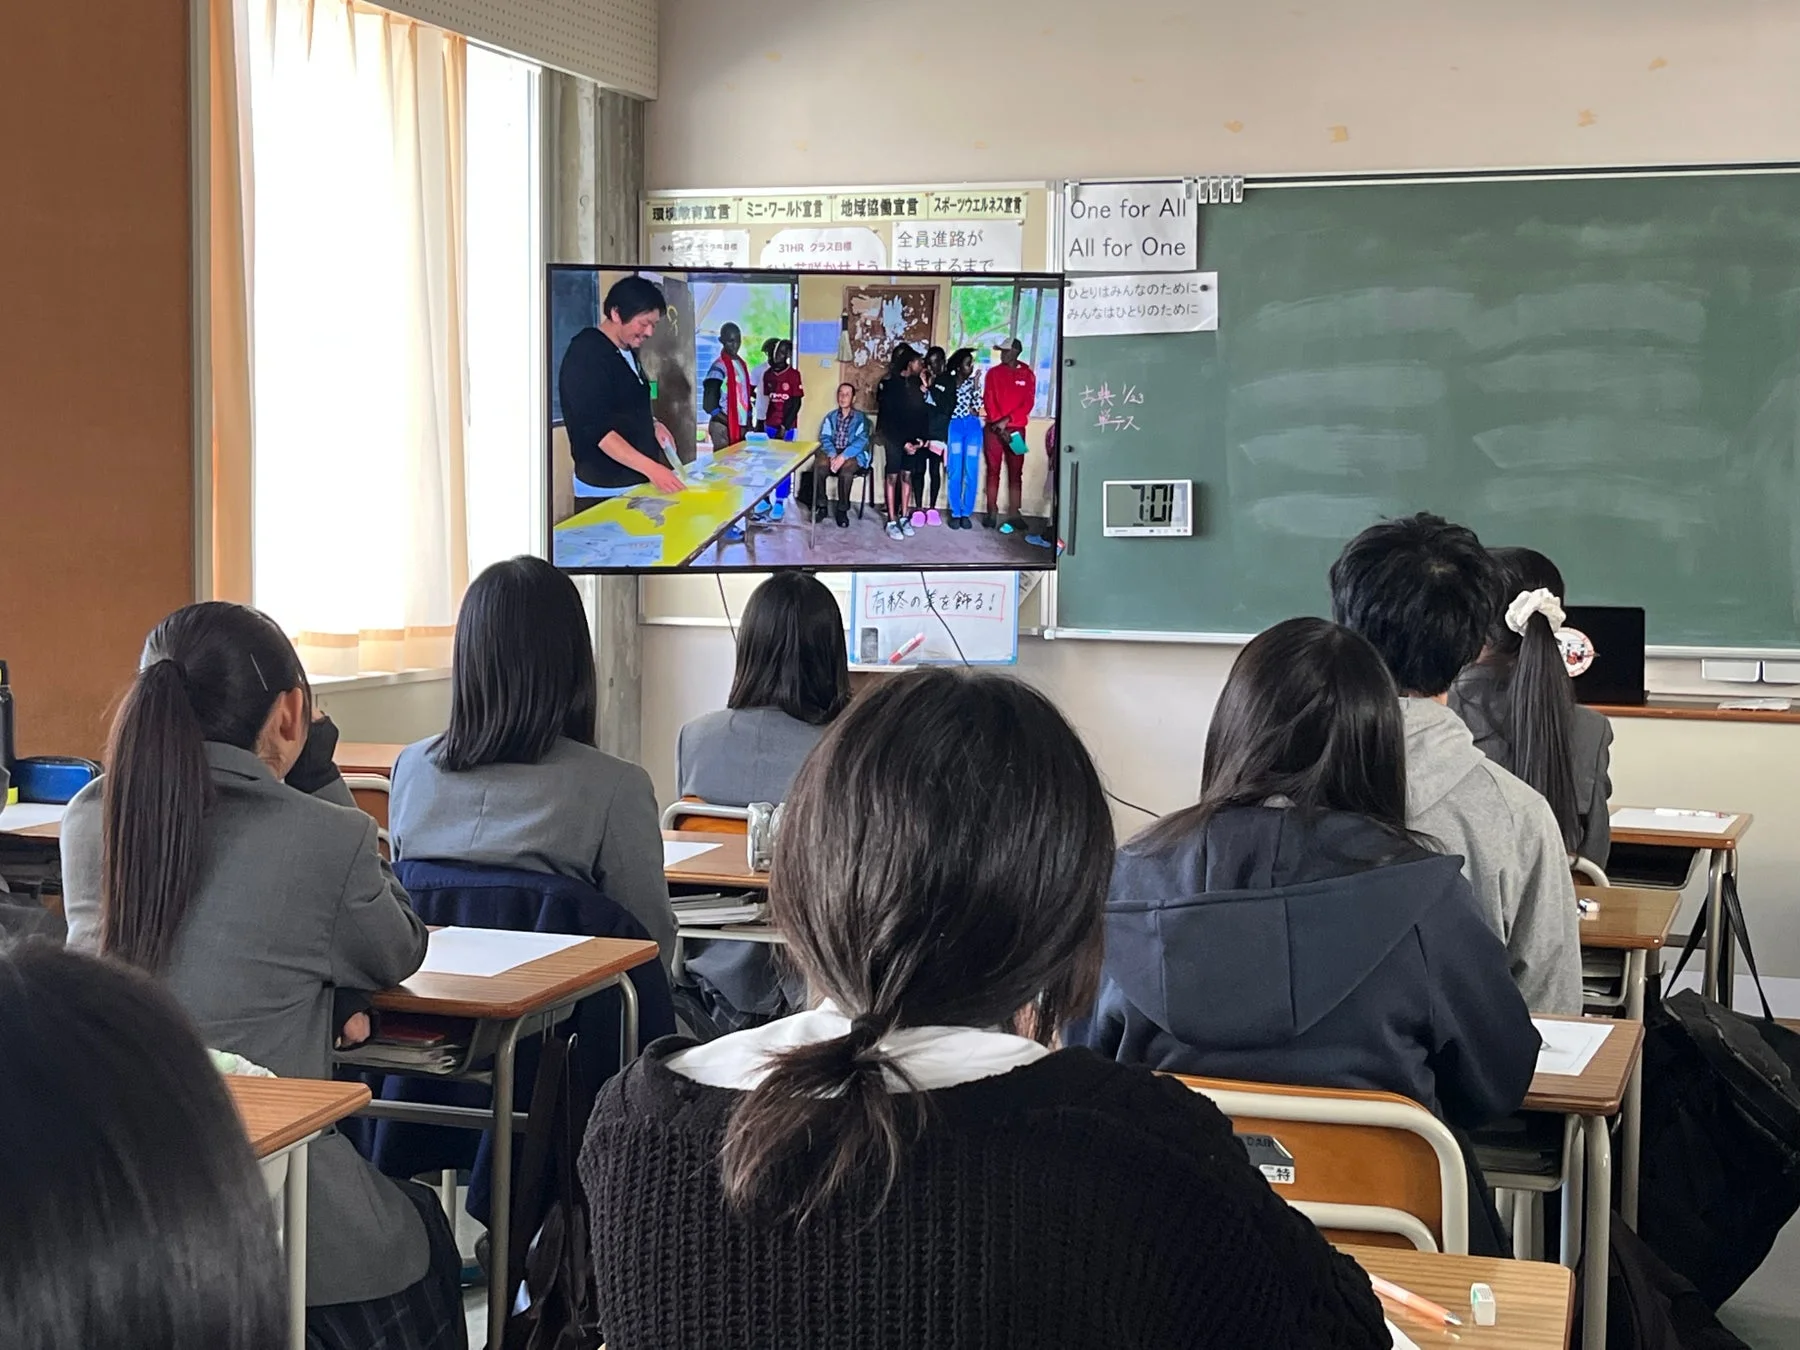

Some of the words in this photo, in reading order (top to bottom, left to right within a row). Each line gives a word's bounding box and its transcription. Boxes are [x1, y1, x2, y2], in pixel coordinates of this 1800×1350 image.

[840, 197, 918, 217] 地域協働宣言
[1070, 199, 1111, 219] One
[1120, 198, 1150, 218] for
[1159, 197, 1187, 217] All
[779, 243, 805, 253] 31HR
[810, 241, 853, 252] クラス目標
[897, 229, 984, 248] 全員進路が
[1069, 237, 1095, 257] All
[1102, 237, 1132, 256] for
[1142, 236, 1186, 256] One
[1067, 282, 1198, 300] ひとりはみんなのために
[1067, 304, 1199, 320] みんなはひとりのために
